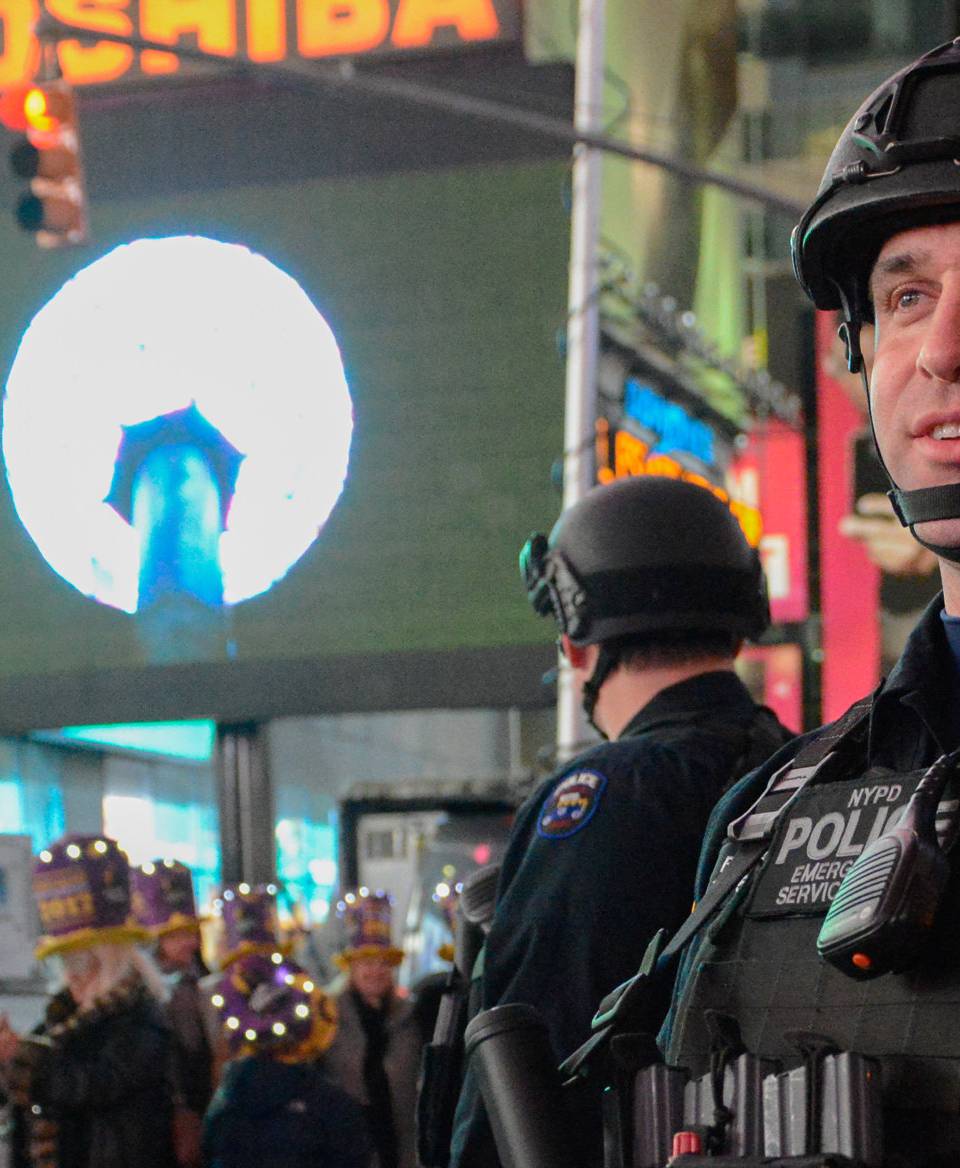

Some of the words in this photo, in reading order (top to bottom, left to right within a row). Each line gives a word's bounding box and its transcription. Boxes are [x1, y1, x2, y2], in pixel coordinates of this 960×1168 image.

[848, 785, 902, 808] NYPD
[791, 860, 852, 883] EMERG
[776, 881, 839, 905] SERVIC
